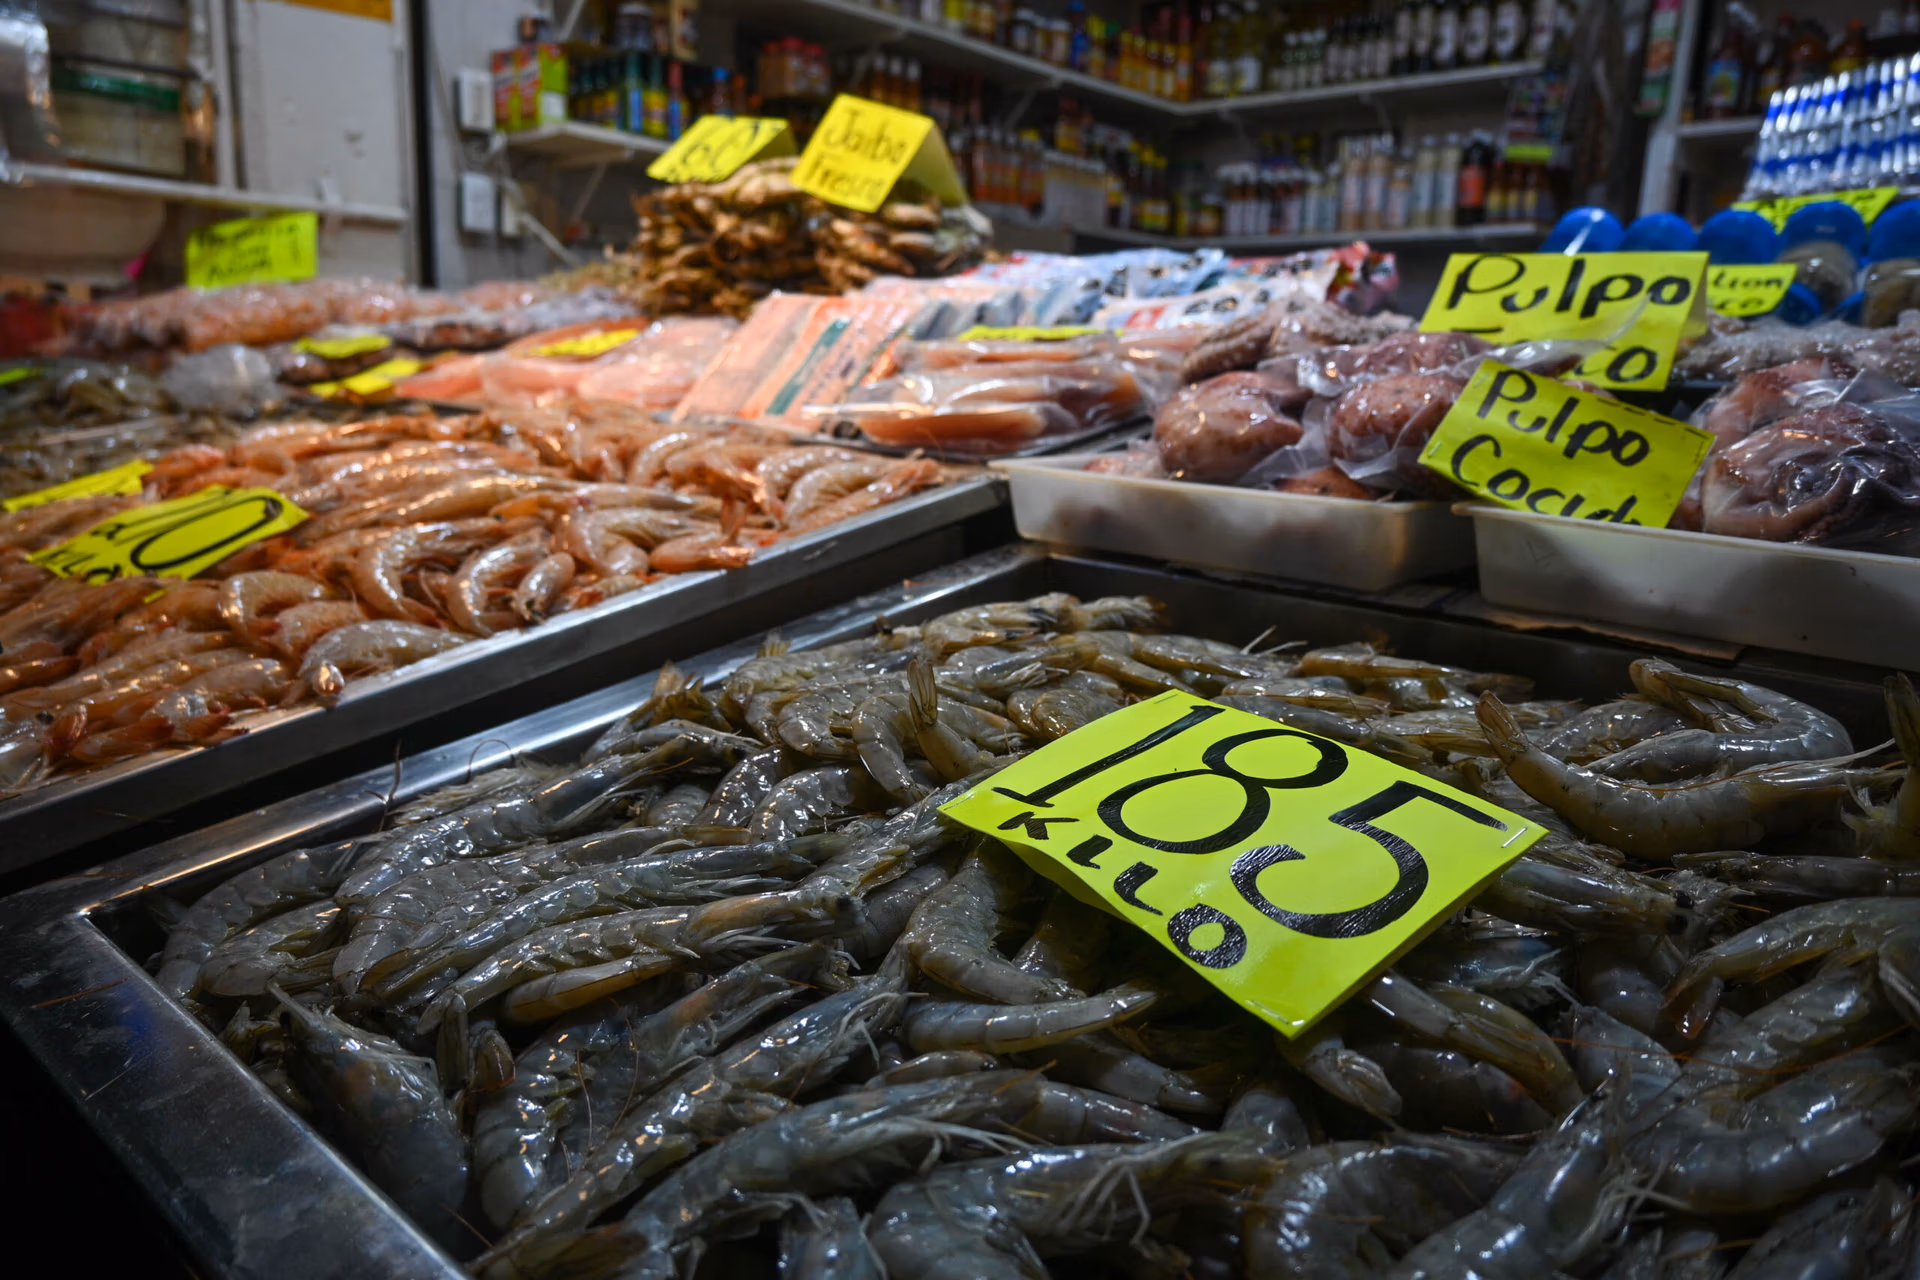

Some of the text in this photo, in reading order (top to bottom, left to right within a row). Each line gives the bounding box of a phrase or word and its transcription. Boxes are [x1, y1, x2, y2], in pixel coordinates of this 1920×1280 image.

[1445, 253, 1691, 320] Pulpo
[1477, 369, 1650, 467] Pulpo
[992, 704, 1508, 939] 185
